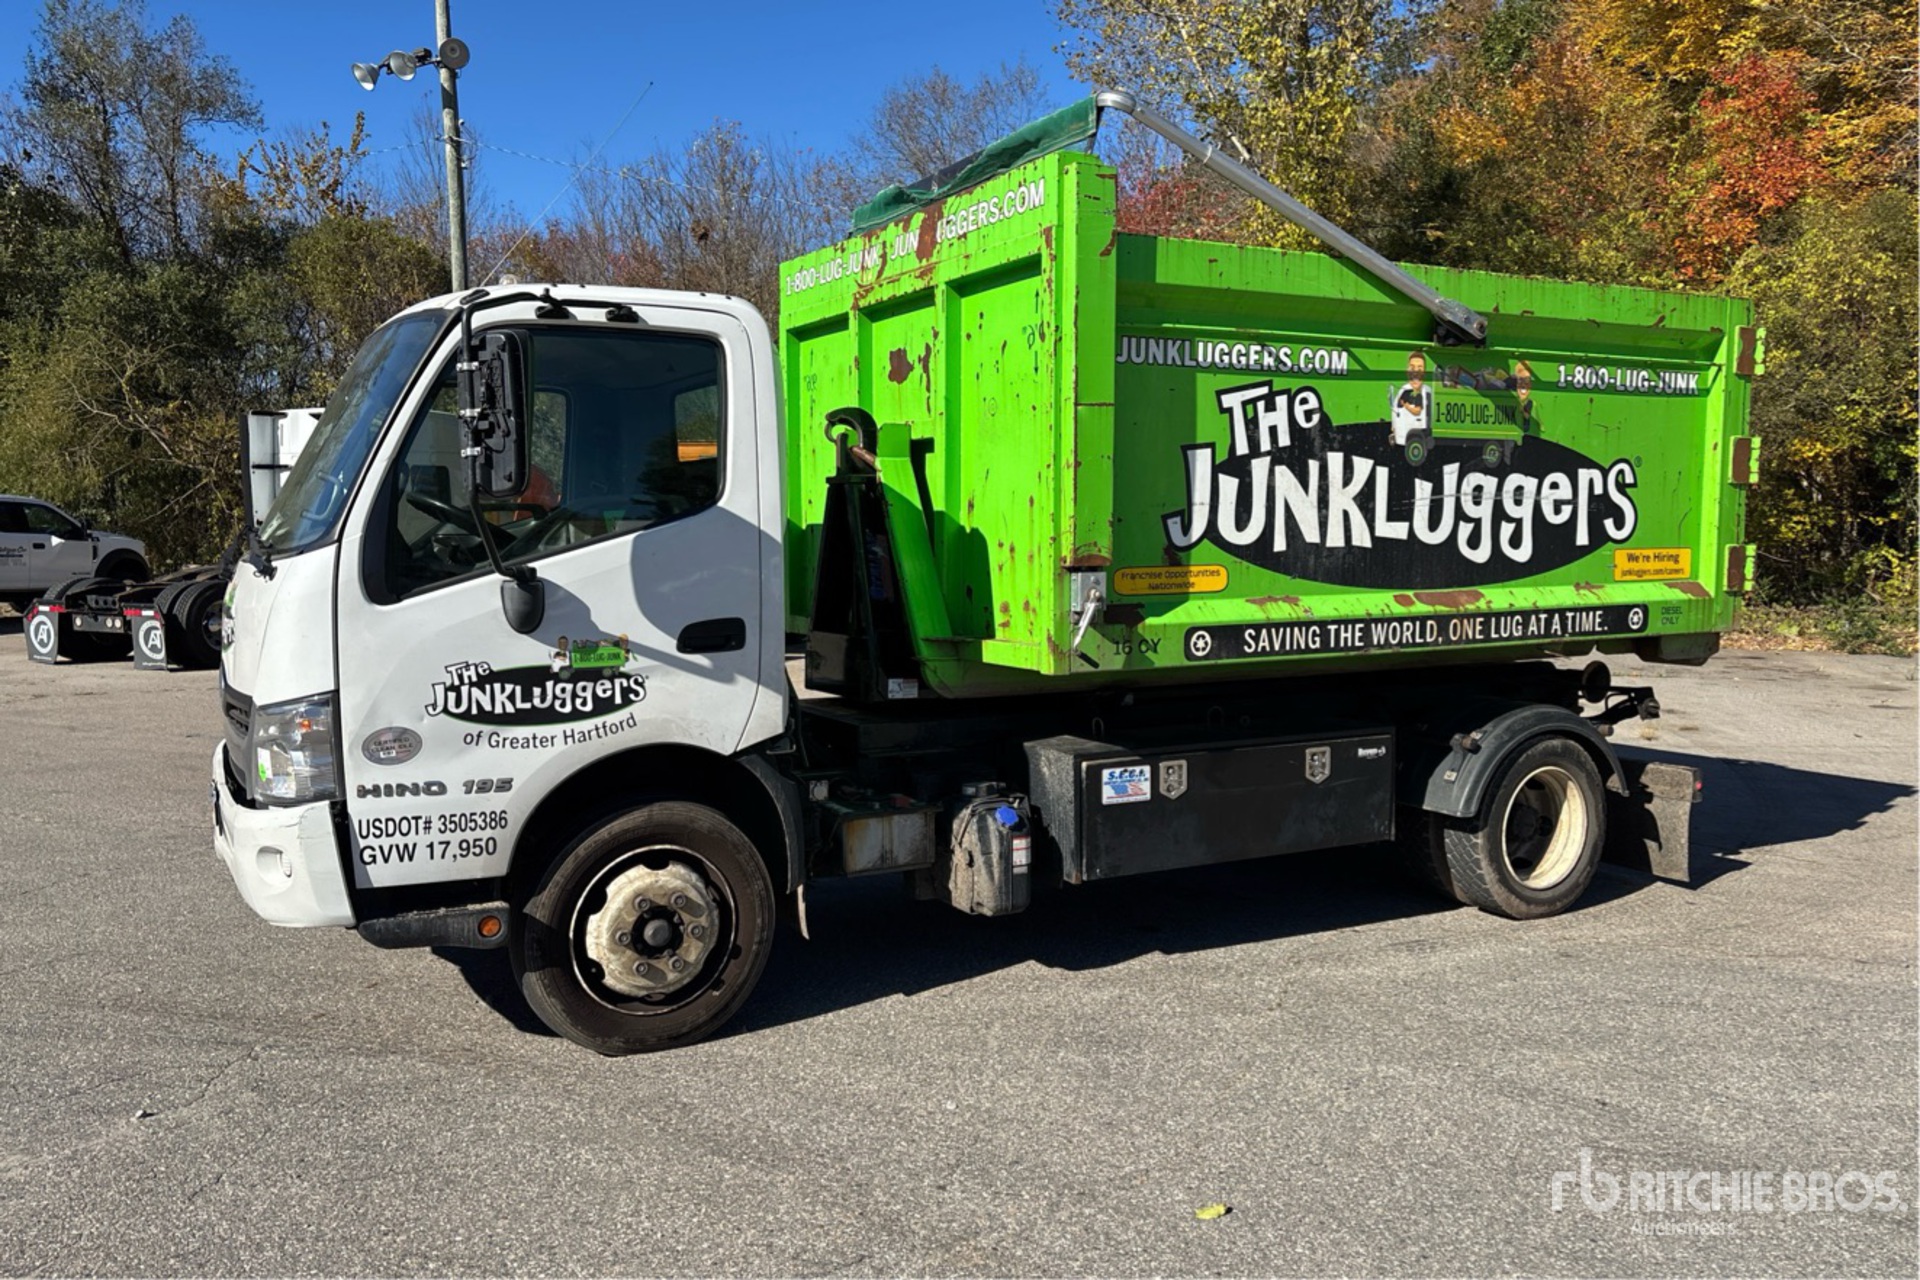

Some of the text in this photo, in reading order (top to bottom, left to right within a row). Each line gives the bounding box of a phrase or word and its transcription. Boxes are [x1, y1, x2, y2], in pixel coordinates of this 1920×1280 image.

[1116, 335, 1348, 375] JUNKLUGGERS.COM
[1557, 363, 1700, 395] 1-800-LUG-JUNK
[1434, 402, 1518, 426] 1-800-LUG-JUNK
[1653, 552, 1680, 565] Hiring
[1121, 570, 1163, 581] Franchise
[1148, 581, 1196, 591] Nationwide
[1243, 610, 1609, 653] SAVING THE WORLD, ONE LUG AT A TIME.
[1113, 640, 1133, 656] 16
[463, 712, 638, 750] of Greater Hartford
[356, 778, 514, 799] HINO 195
[358, 810, 509, 840] USDOT# 3505386
[359, 837, 498, 866] GVW 17,950
